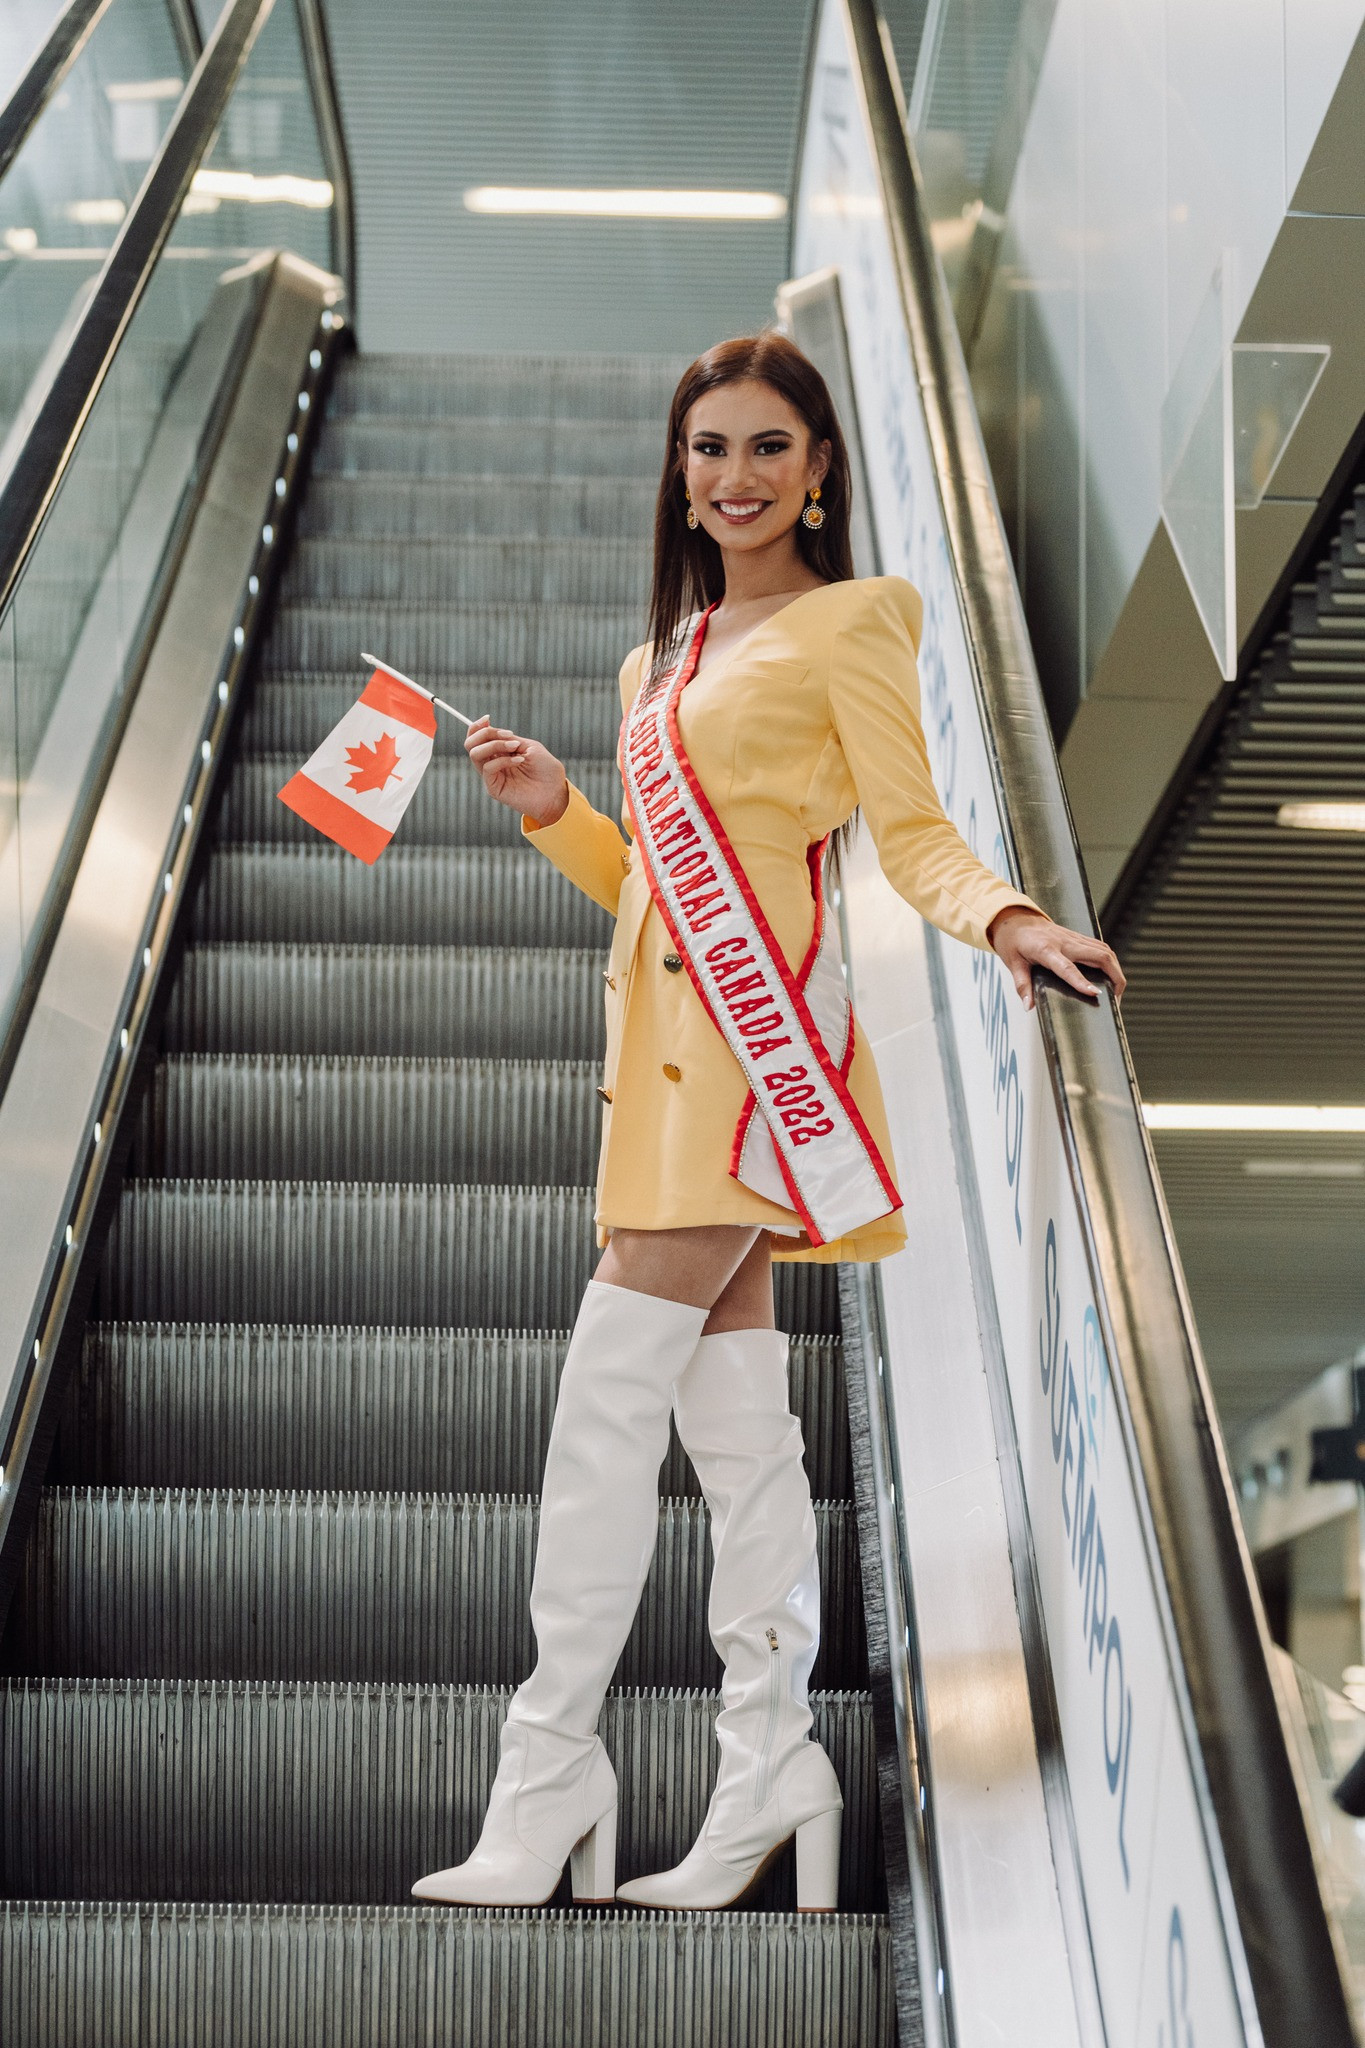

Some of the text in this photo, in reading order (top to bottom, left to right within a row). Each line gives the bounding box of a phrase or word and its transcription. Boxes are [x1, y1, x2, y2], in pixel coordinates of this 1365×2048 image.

[629, 711, 732, 935] SUPRANATIONAL
[704, 936, 793, 1061] CANADA
[762, 1064, 836, 1148] 2022
[1039, 1217, 1132, 1894] SUEMPOL
